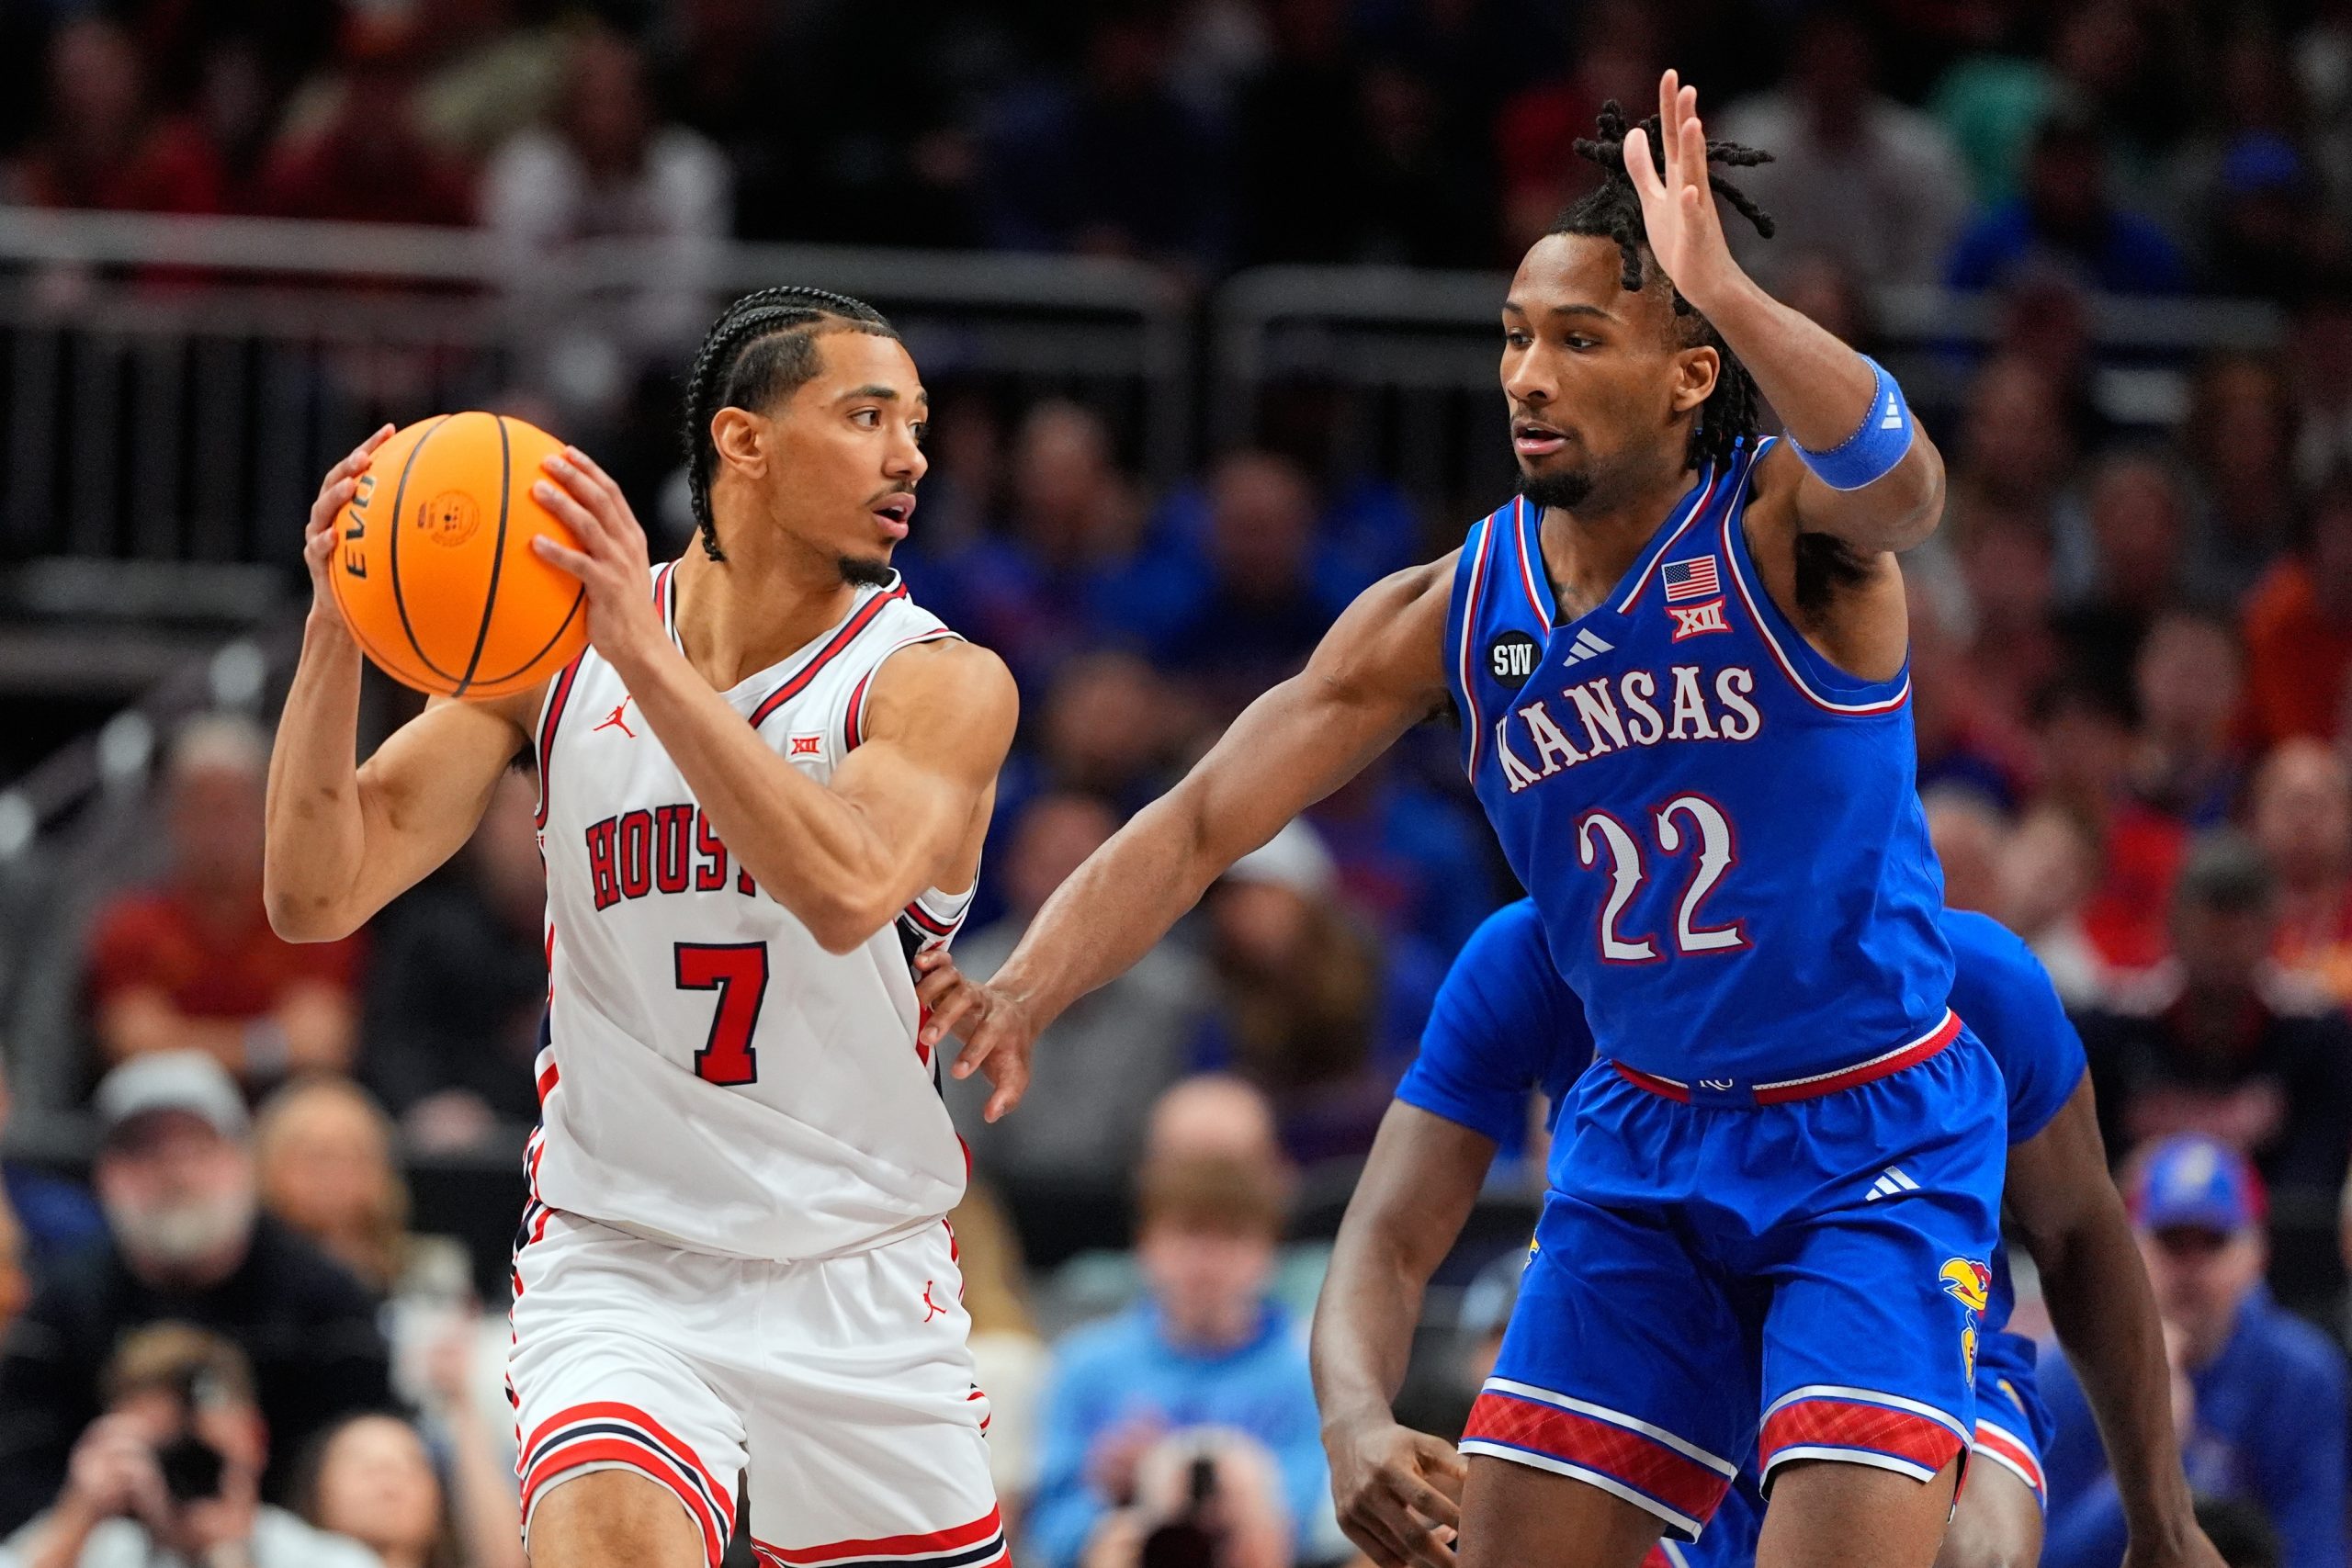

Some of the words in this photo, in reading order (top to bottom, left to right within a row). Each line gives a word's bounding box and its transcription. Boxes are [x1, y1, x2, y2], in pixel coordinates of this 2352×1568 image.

[1493, 643, 1533, 676] SW
[1667, 598, 1730, 640] XII
[791, 737, 820, 756] XII
[1495, 666, 1761, 794] KANSAS
[585, 803, 756, 912] HOUS
[1577, 793, 1750, 964] 22
[674, 941, 770, 1087] 7
